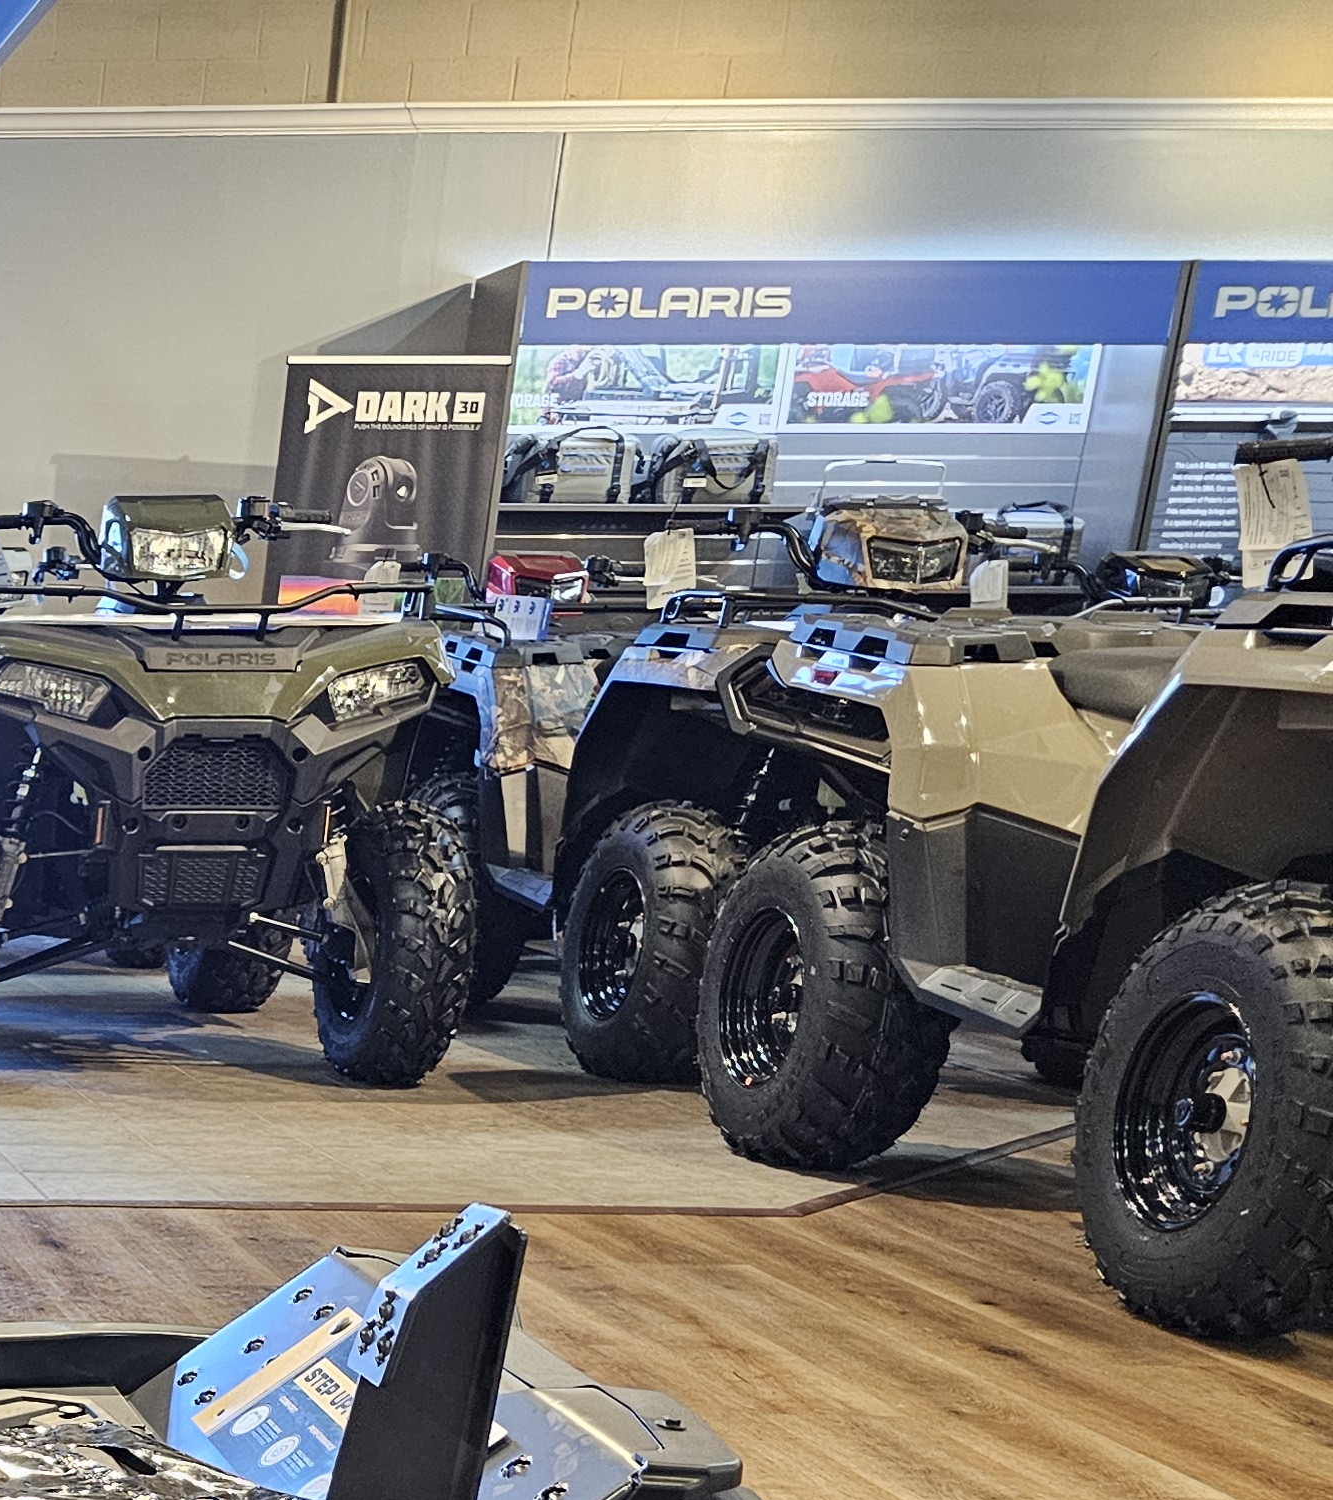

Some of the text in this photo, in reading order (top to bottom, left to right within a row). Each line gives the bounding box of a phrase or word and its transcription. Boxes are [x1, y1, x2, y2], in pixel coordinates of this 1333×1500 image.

[546, 286, 792, 319] POLARIS
[1214, 286, 1333, 318] POL
[354, 391, 480, 422] DARK 30
[807, 391, 870, 408] STORAGE
[166, 651, 278, 666] POLARIS
[303, 1367, 341, 1397] STEP
